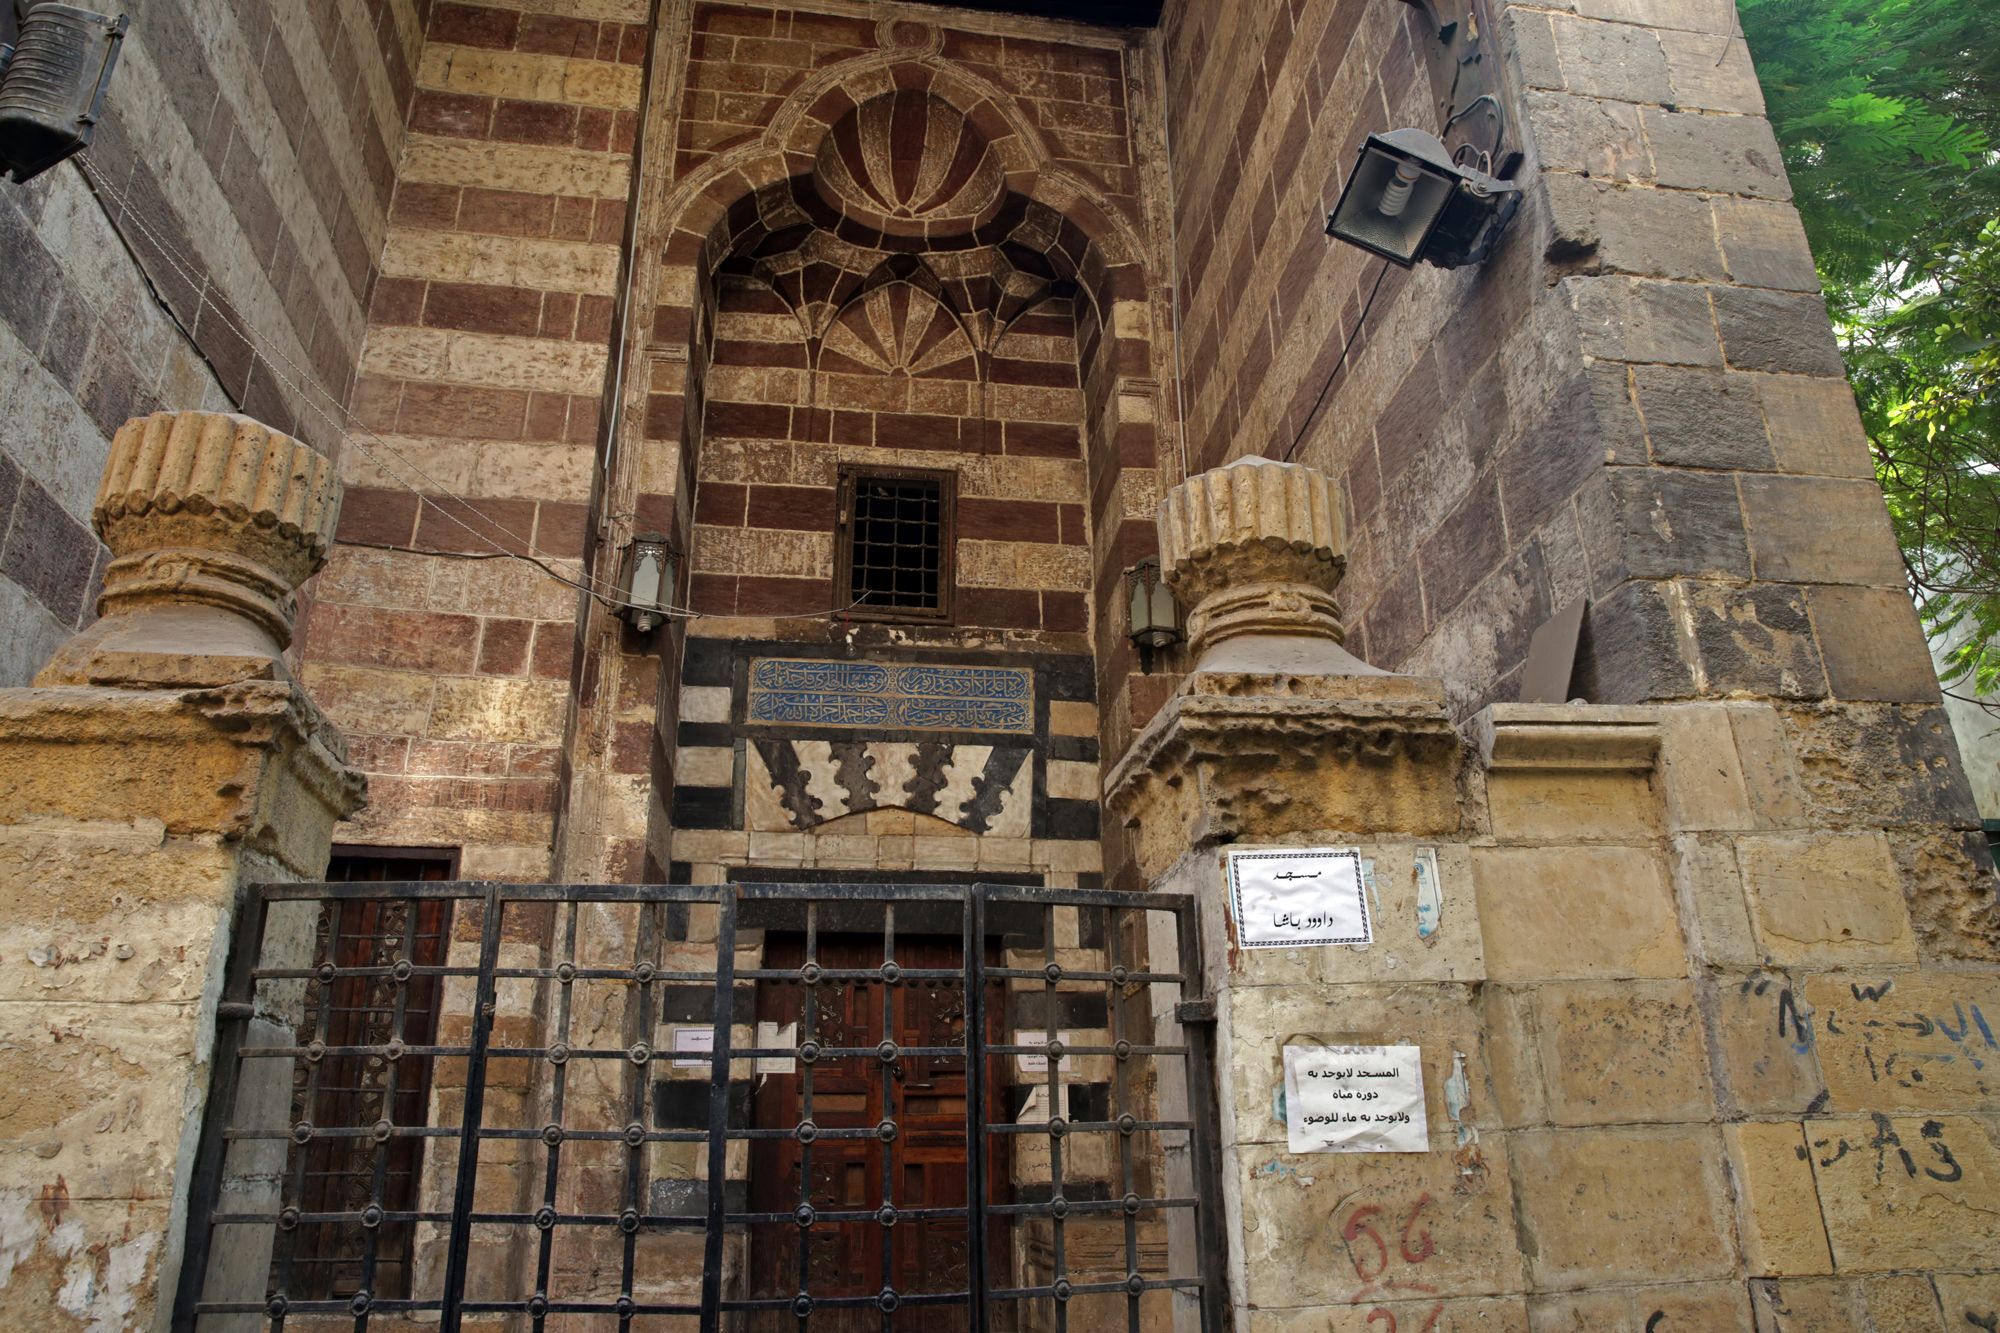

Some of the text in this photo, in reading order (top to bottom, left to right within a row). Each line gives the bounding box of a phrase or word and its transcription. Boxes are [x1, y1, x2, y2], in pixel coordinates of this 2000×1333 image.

[1273, 871, 1322, 881] مسجد
[1273, 910, 1334, 930] داوود باشا
[1307, 1069, 1319, 1079] به
[1356, 1067, 1400, 1079] المسجد
[1332, 1089, 1353, 1101] مياه
[1303, 1112, 1339, 1125] للوضوء
[1342, 1112, 1357, 1123] ماء
[1360, 1113, 1371, 1124] به
